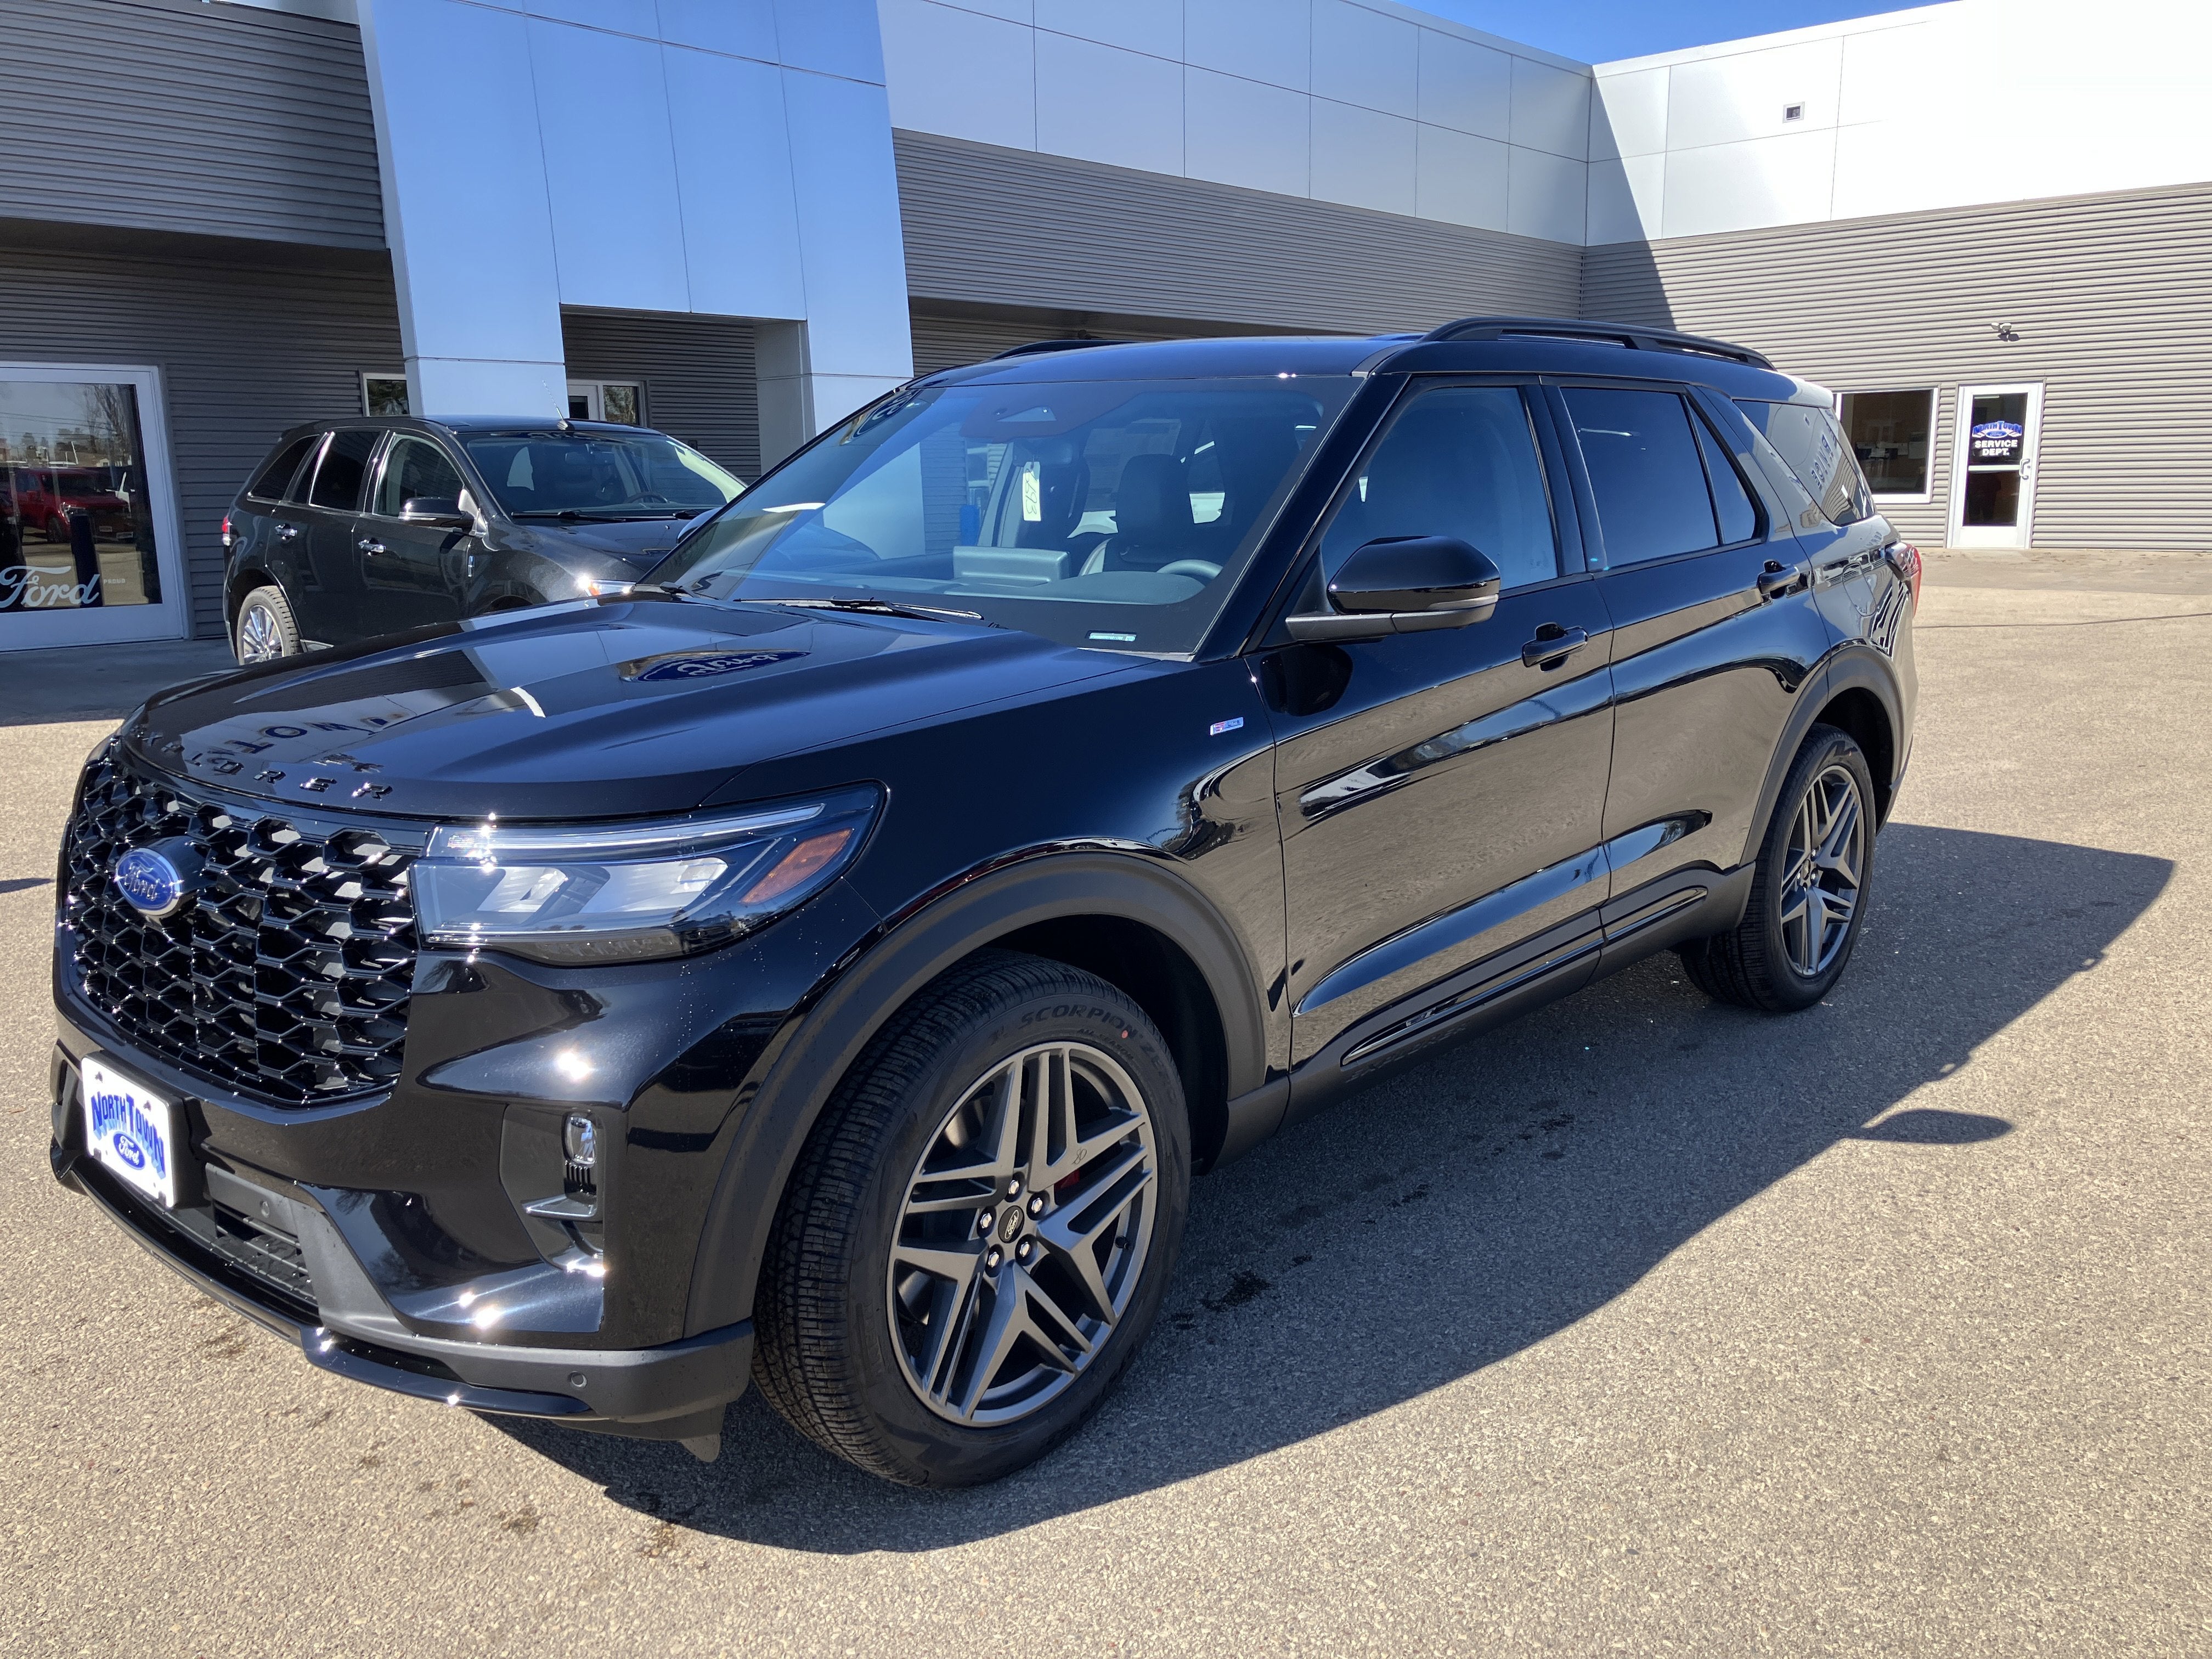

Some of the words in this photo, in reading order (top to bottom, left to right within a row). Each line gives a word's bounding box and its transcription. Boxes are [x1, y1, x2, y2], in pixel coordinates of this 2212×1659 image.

[1972, 422, 1997, 435] NORTH
[1996, 421, 2022, 435] TOWN
[1975, 439, 2018, 448] SERVICE
[1982, 448, 2010, 456] DEPT.
[0, 565, 100, 608] Ford
[125, 861, 160, 901] Ford
[1018, 1004, 1138, 1039] SCORPION
[91, 1091, 127, 1133] NORTH
[126, 1092, 165, 1177] TOWN
[119, 1135, 140, 1165] Ford
[1007, 1215, 1018, 1235] Ford
